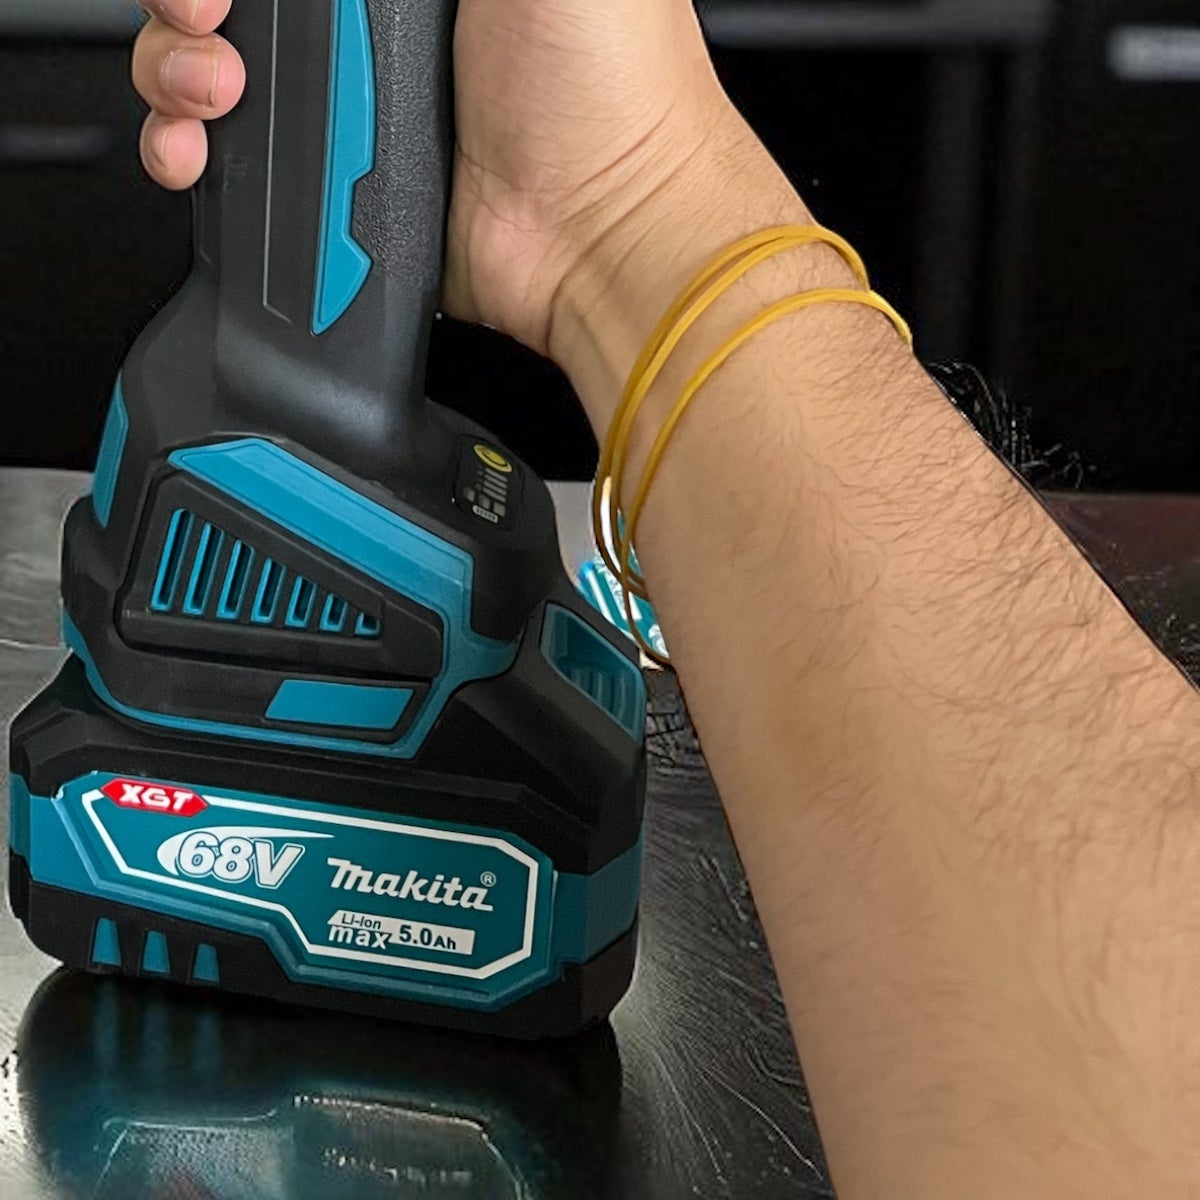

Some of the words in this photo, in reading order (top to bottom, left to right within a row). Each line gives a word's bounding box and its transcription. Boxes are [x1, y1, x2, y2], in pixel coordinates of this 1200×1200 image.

[119, 783, 195, 812] XGT
[176, 830, 306, 890] 68V
[328, 924, 392, 950] max
[398, 923, 457, 951] 5.0Ah
